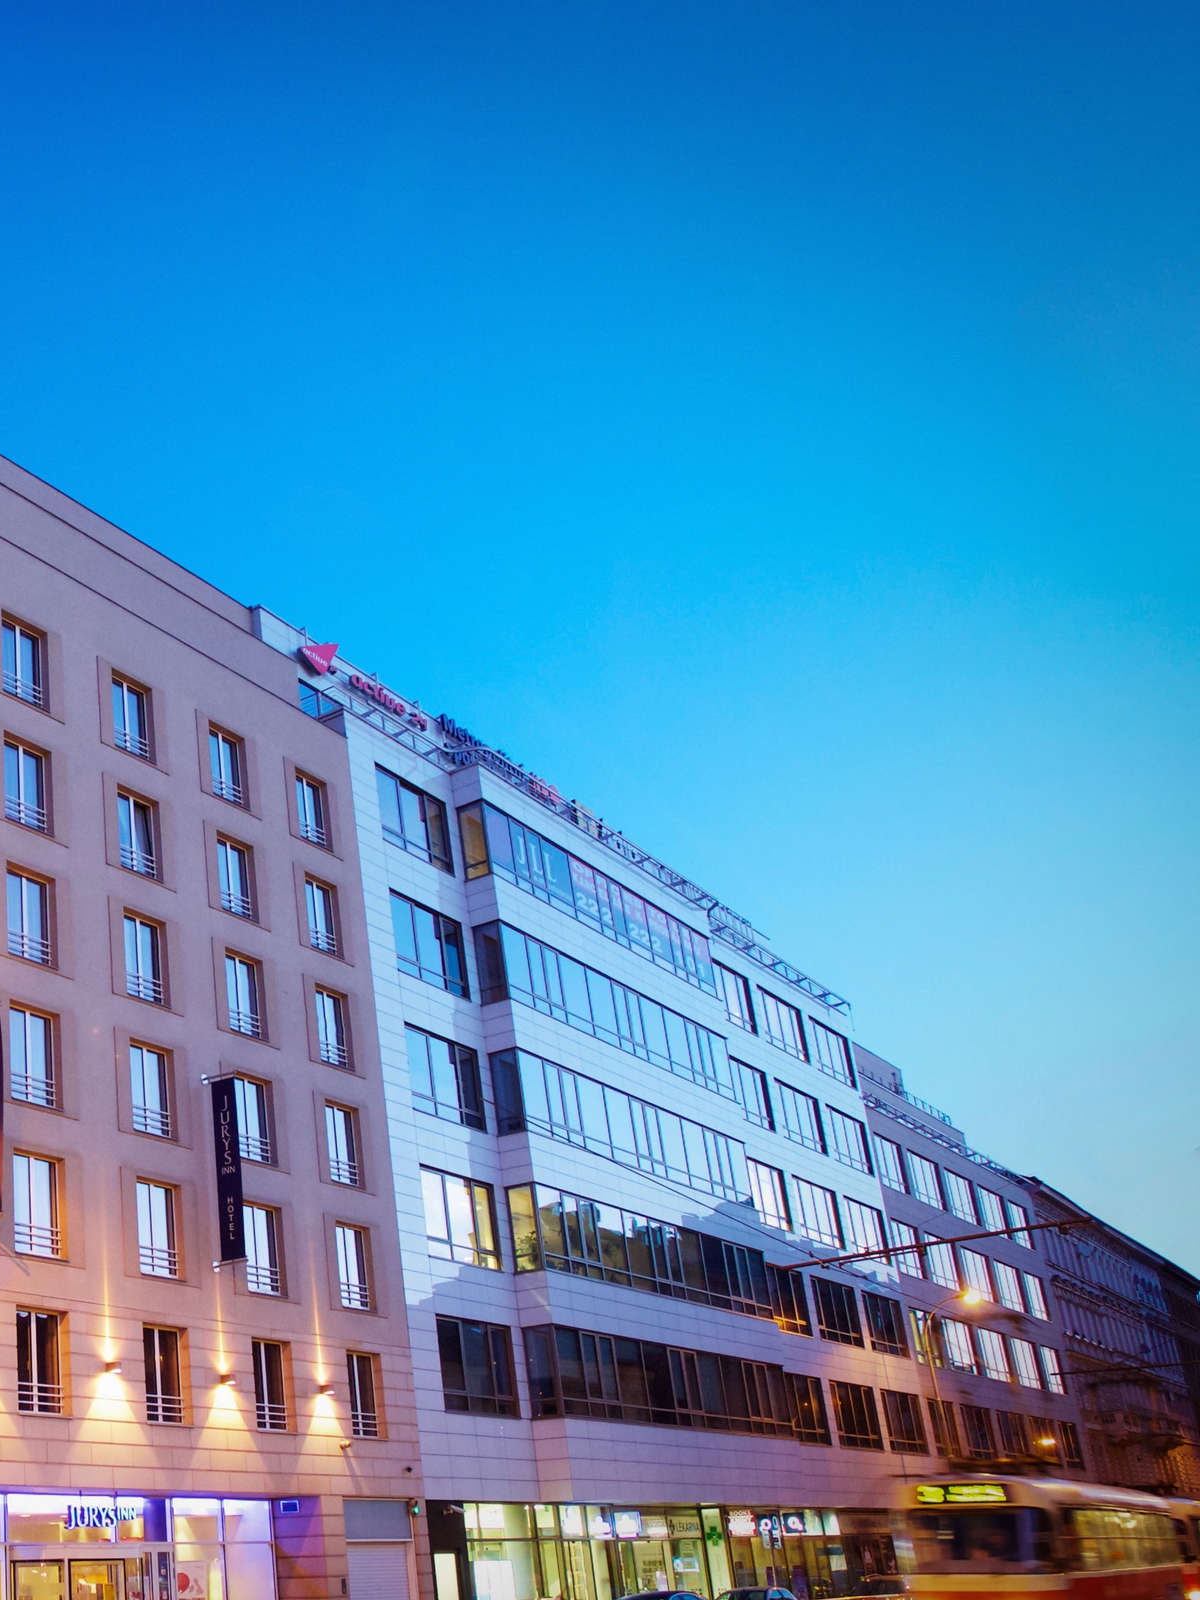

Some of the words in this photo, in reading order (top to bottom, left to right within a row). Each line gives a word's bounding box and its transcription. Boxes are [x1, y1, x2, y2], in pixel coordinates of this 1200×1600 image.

[220, 1096, 231, 1165] JURYS
[222, 1166, 235, 1175] INN
[227, 1197, 235, 1240] HOTEL
[64, 1504, 117, 1531] JURYS
[117, 1504, 137, 1521] INN
